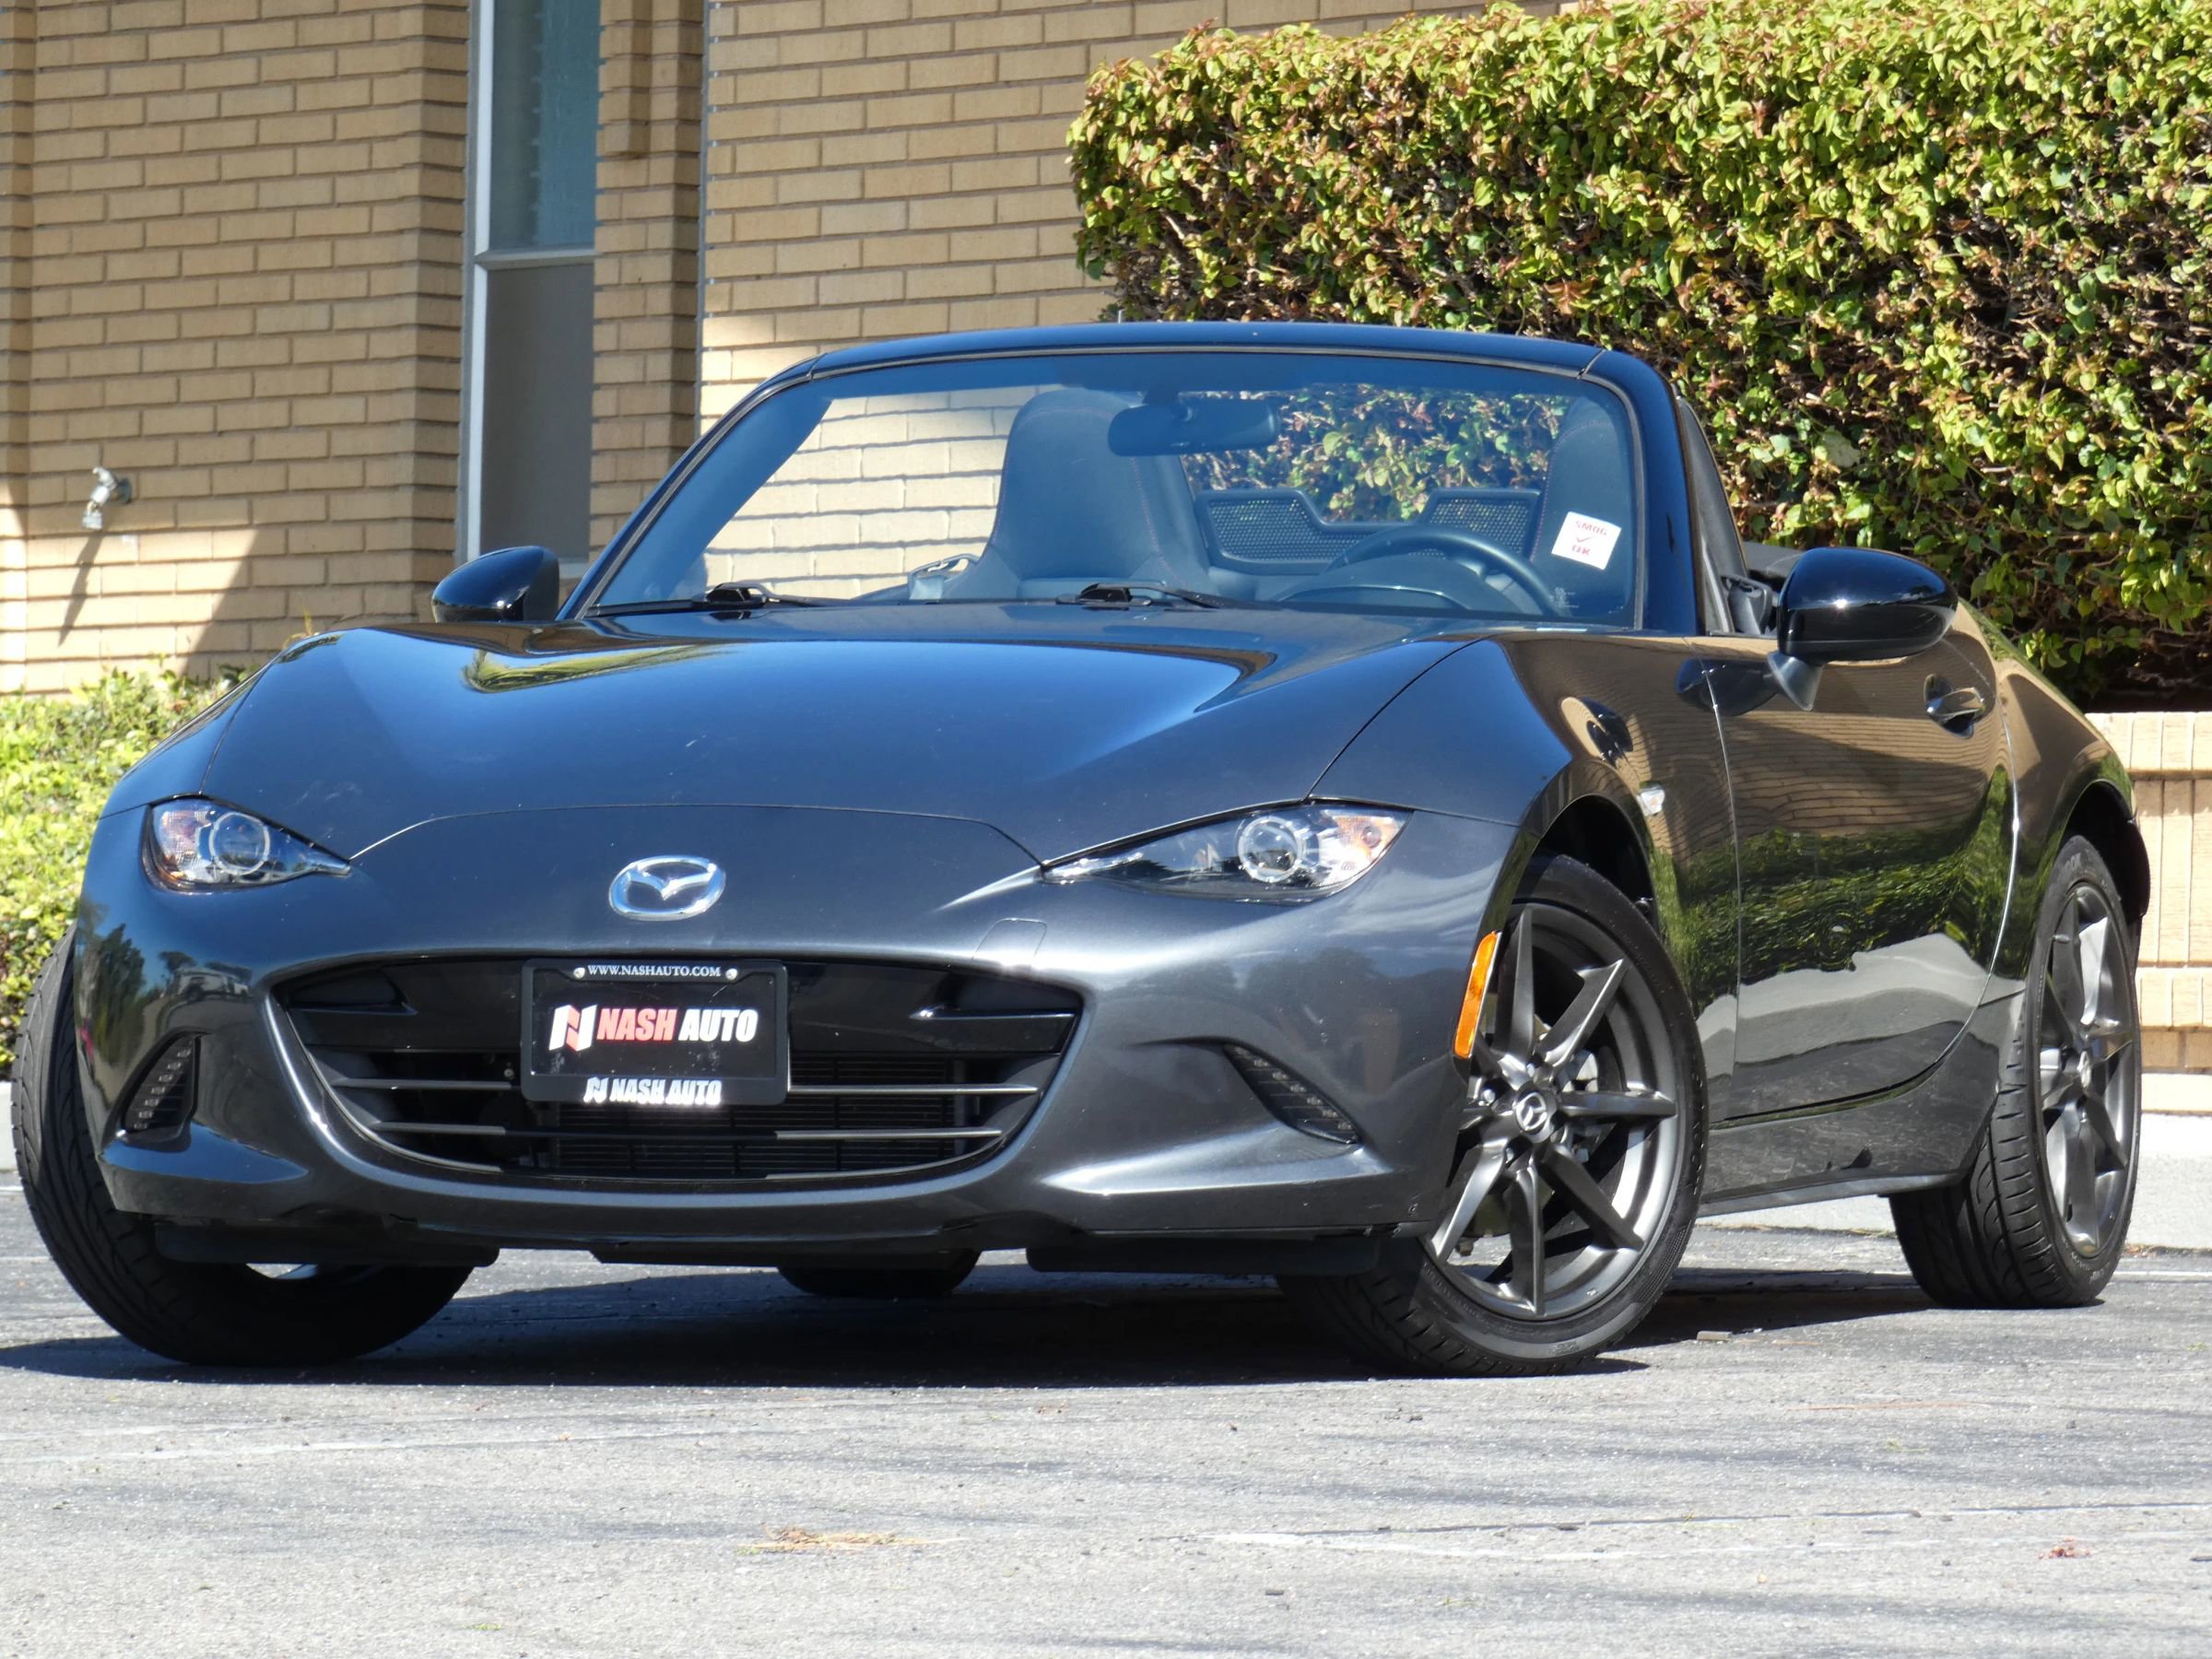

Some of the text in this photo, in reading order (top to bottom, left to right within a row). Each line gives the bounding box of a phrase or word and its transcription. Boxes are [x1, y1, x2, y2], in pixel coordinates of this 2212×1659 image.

[1576, 521, 1606, 535] SMOG
[1571, 545, 1591, 556] OK
[588, 965, 721, 977] WWW.NASHAUTO.COM
[596, 1008, 678, 1041] NASH
[678, 1008, 759, 1042] AUTO
[609, 1078, 665, 1104] NASH
[665, 1079, 722, 1105] AUTO
